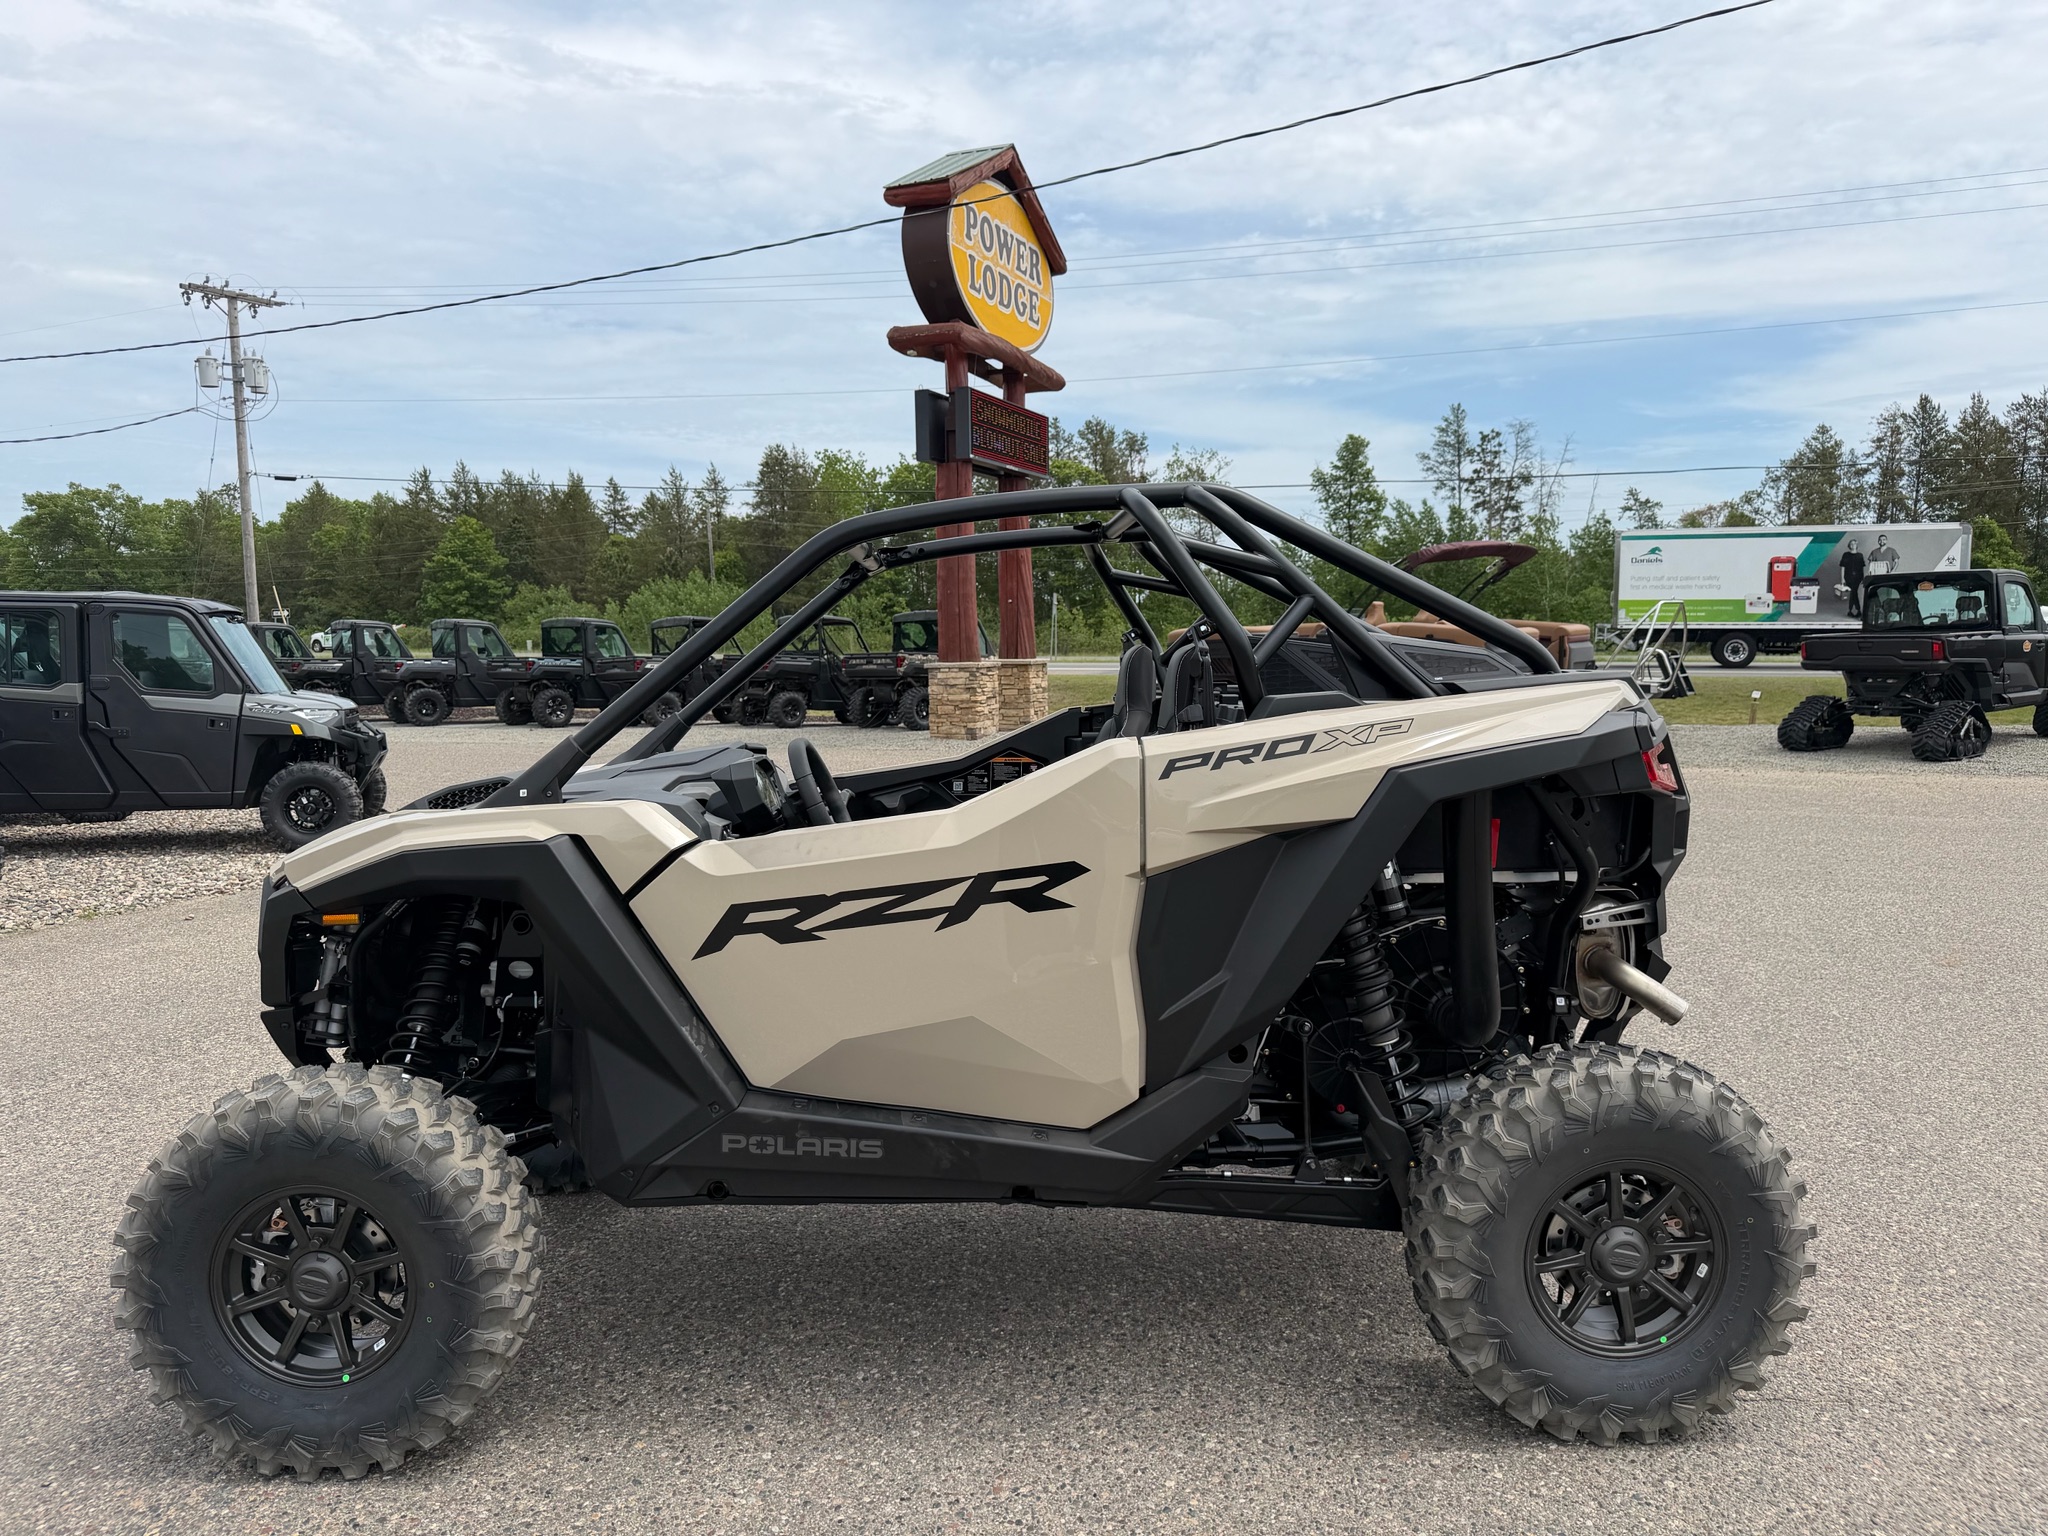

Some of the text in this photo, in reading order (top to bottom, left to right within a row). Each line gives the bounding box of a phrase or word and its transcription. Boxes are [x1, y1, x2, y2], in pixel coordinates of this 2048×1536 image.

[964, 203, 1042, 287] POWER
[968, 254, 1041, 327] LODGE
[973, 425, 1046, 465] BLOWOUT SALE
[976, 400, 1041, 440] SNOWMOBILE
[1158, 718, 1414, 780] PRO XP
[691, 860, 1091, 961] RZR
[721, 1134, 884, 1159] POLARIS
